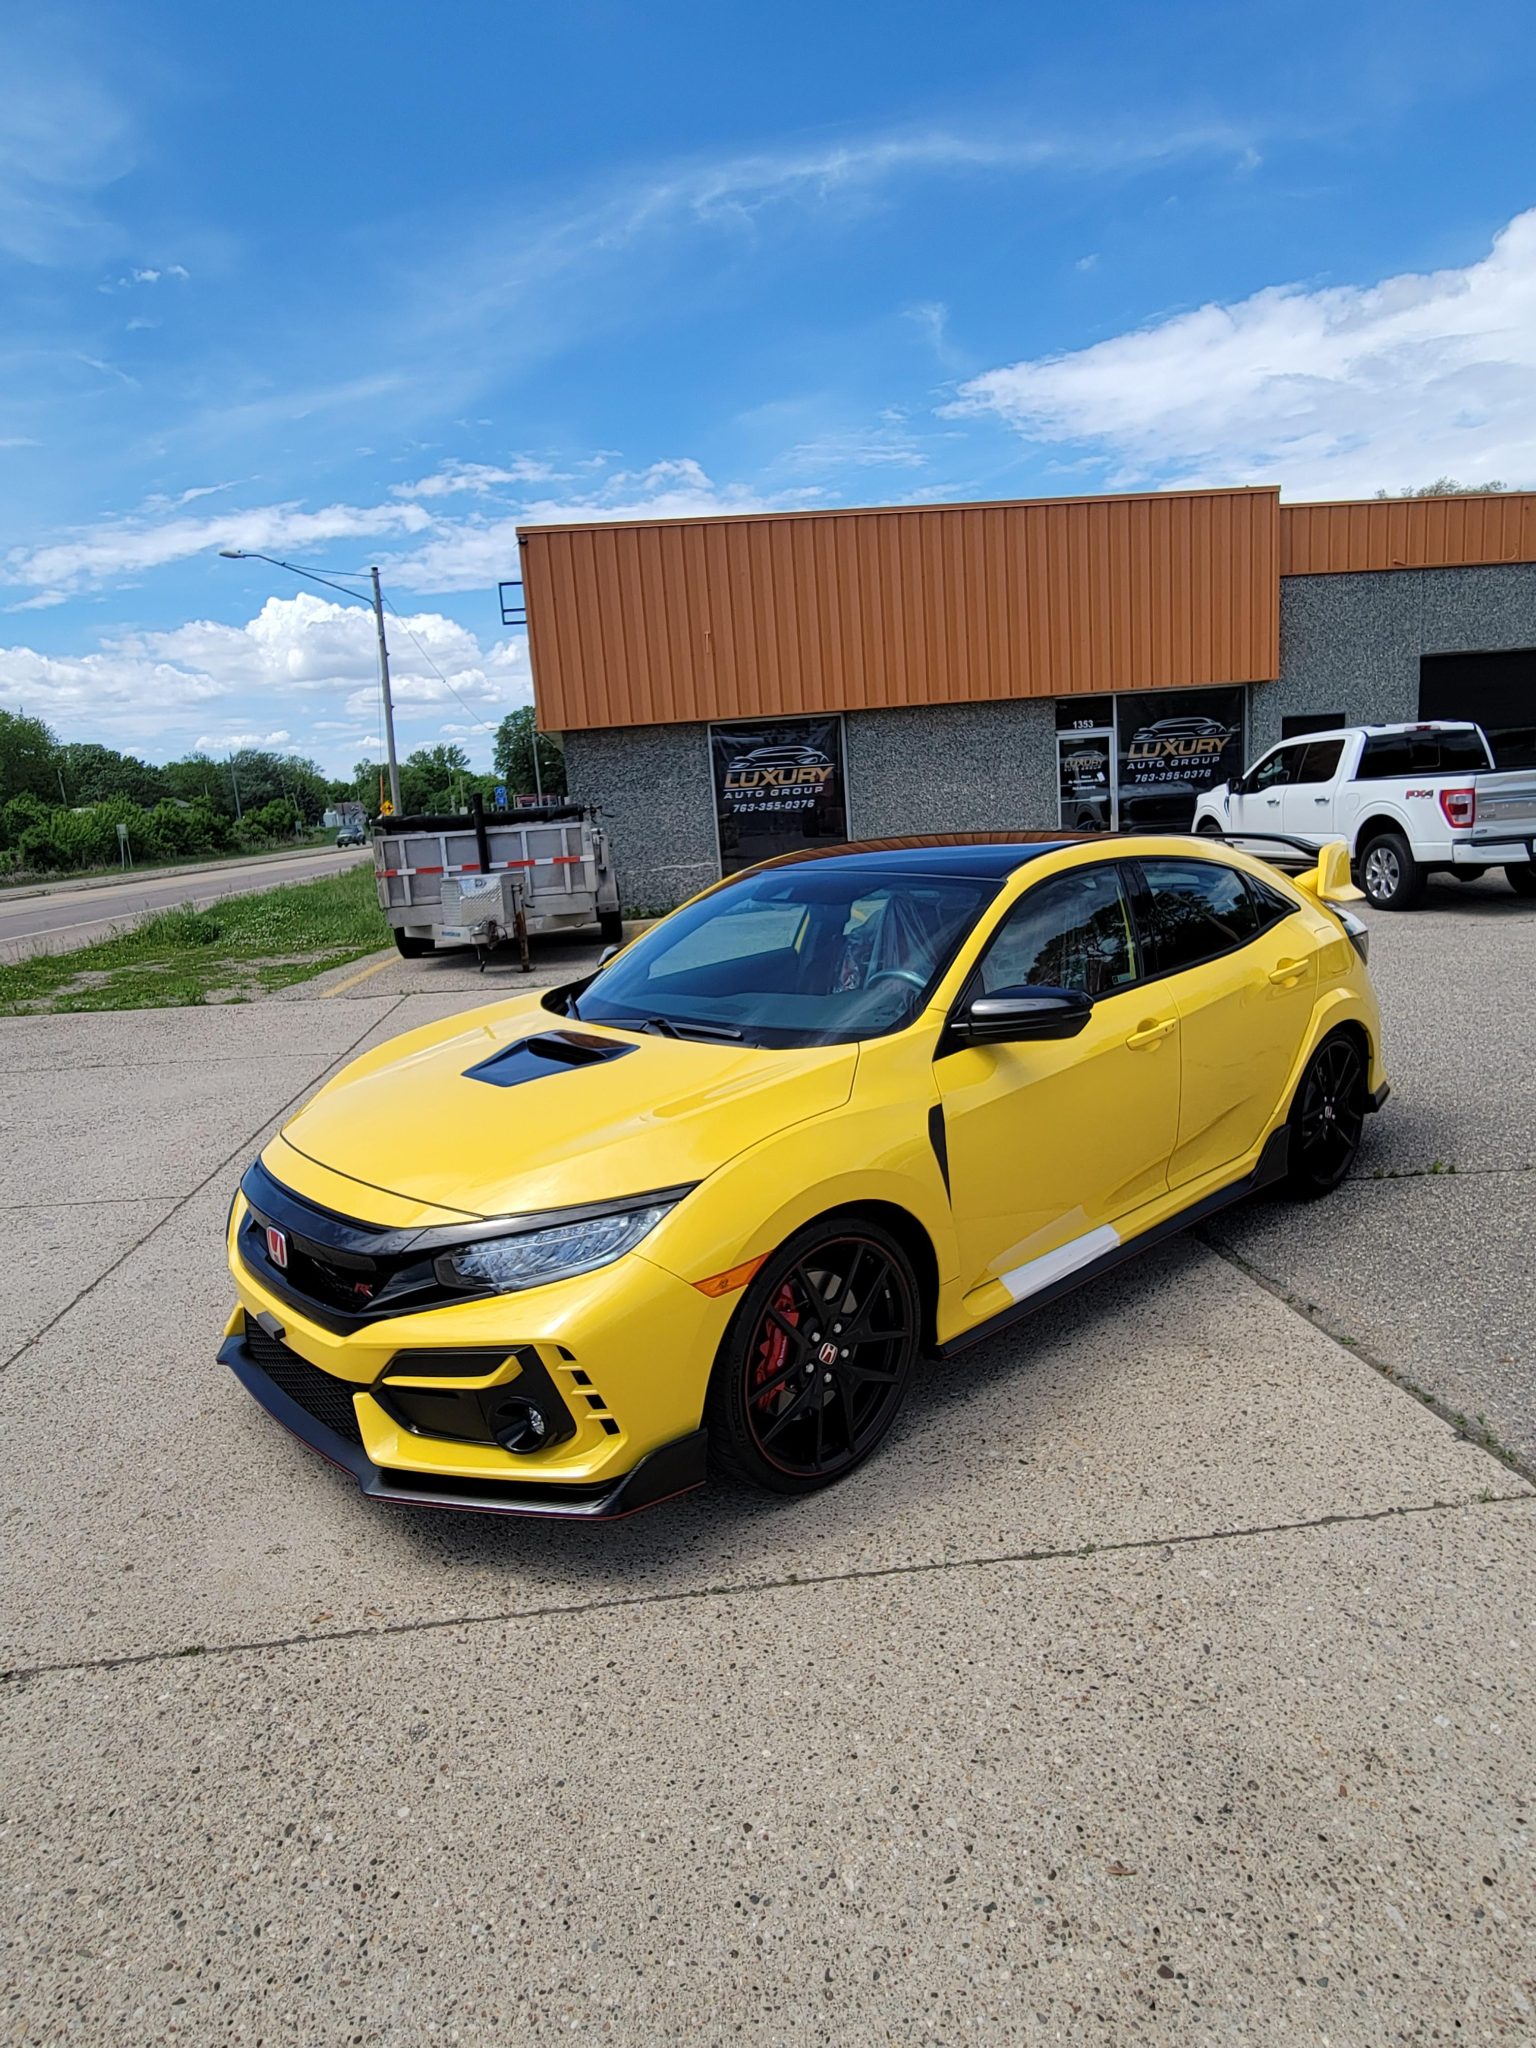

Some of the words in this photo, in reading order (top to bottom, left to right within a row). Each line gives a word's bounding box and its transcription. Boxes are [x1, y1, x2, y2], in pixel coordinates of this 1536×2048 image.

[1073, 720, 1094, 729] 1353
[1128, 737, 1230, 759] LUXURY
[1127, 761, 1165, 770] AUTO
[1170, 757, 1220, 767] GROUP
[725, 767, 833, 788] LUXURY
[724, 790, 765, 799] AUTO
[770, 786, 824, 797] GROUP
[1405, 790, 1434, 799] FX4
[733, 800, 815, 812] 763-355-0376
